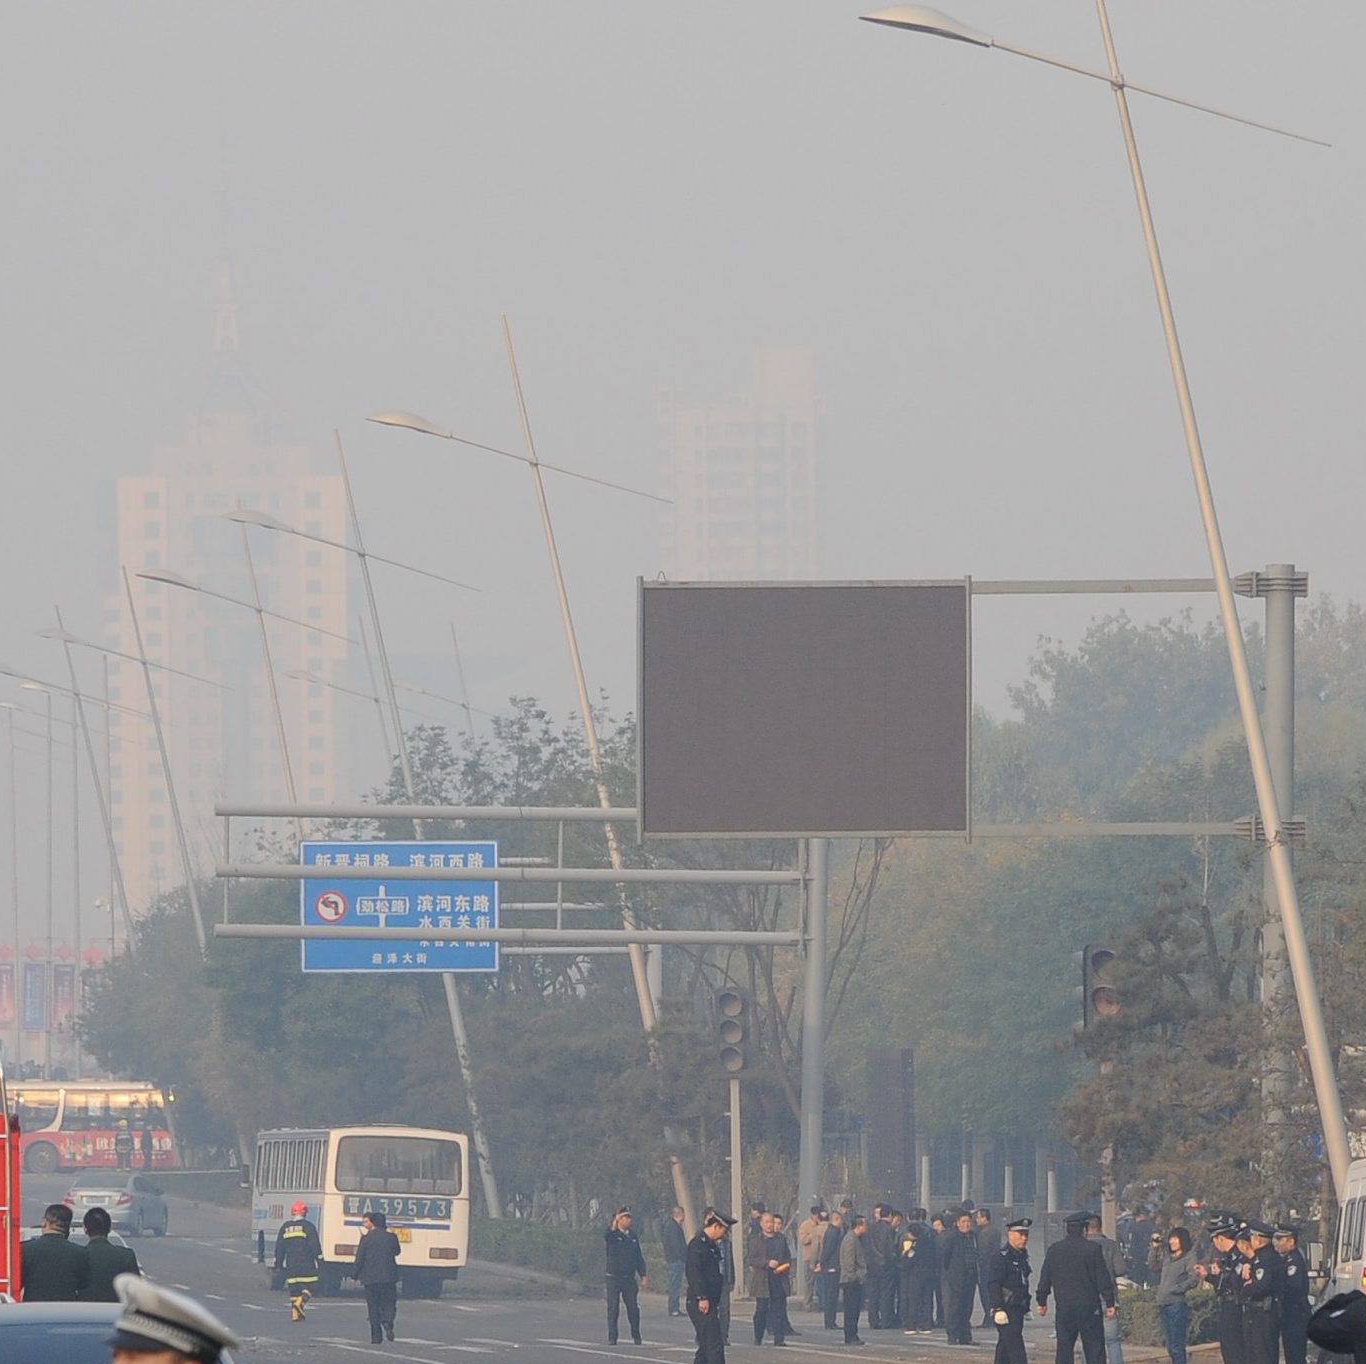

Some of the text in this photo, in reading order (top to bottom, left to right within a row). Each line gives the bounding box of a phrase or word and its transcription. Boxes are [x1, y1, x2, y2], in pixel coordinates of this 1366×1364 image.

[410, 853, 484, 868] 滨河西路
[417, 895, 490, 913] 滨河东路
